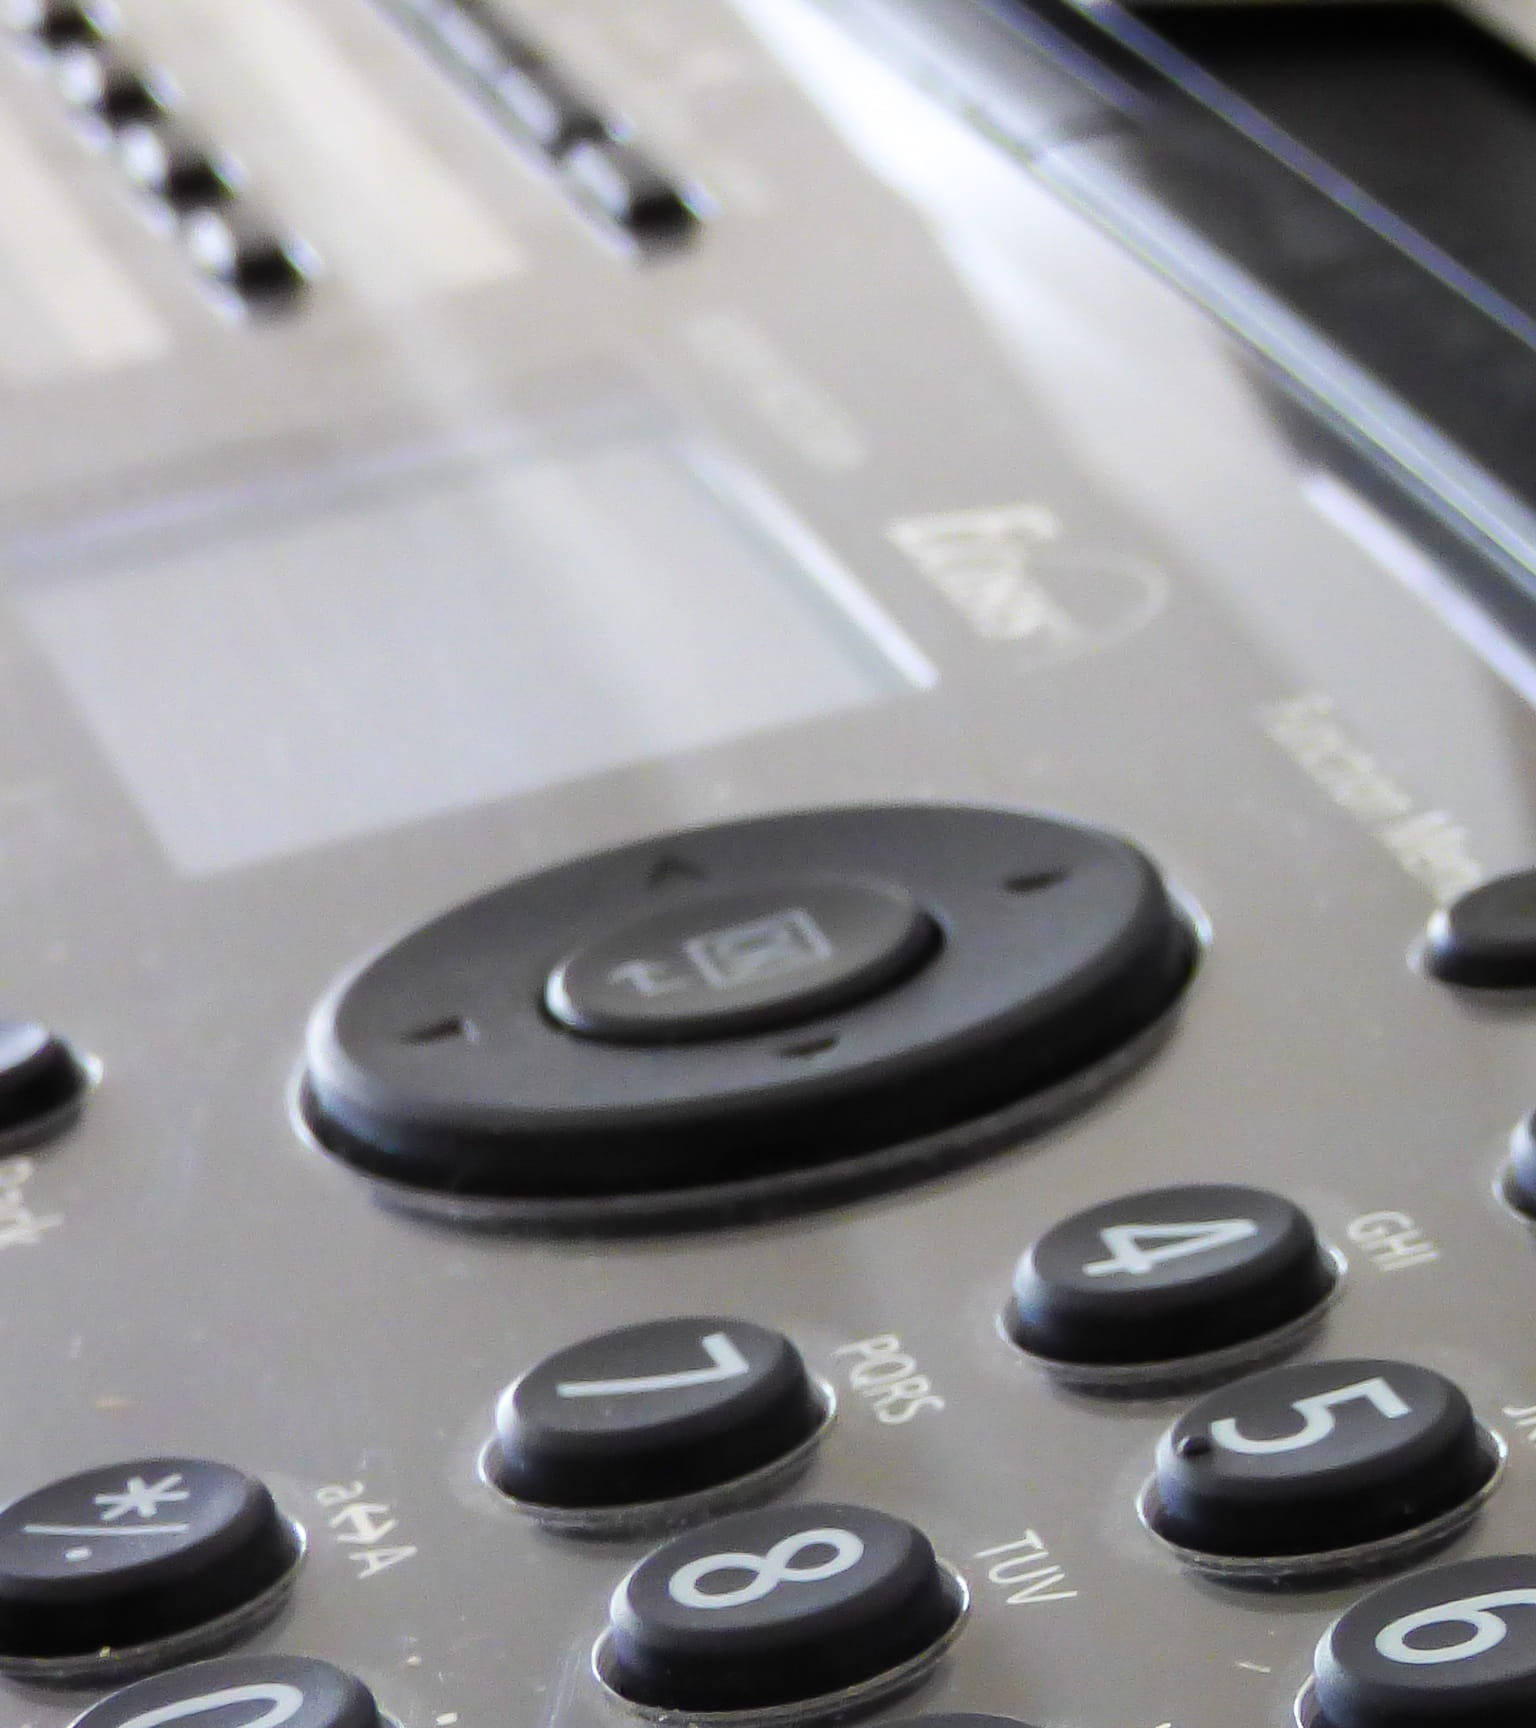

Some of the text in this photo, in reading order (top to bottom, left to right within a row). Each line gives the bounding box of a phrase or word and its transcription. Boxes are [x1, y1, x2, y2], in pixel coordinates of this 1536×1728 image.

[1083, 1218, 1260, 1276] 4
[1347, 1211, 1443, 1272] GHI
[556, 1334, 750, 1399] 7
[830, 1334, 945, 1424] PQRS
[1210, 1378, 1410, 1454] 5
[668, 1527, 865, 1610] 8
[973, 1529, 1078, 1606] TUV
